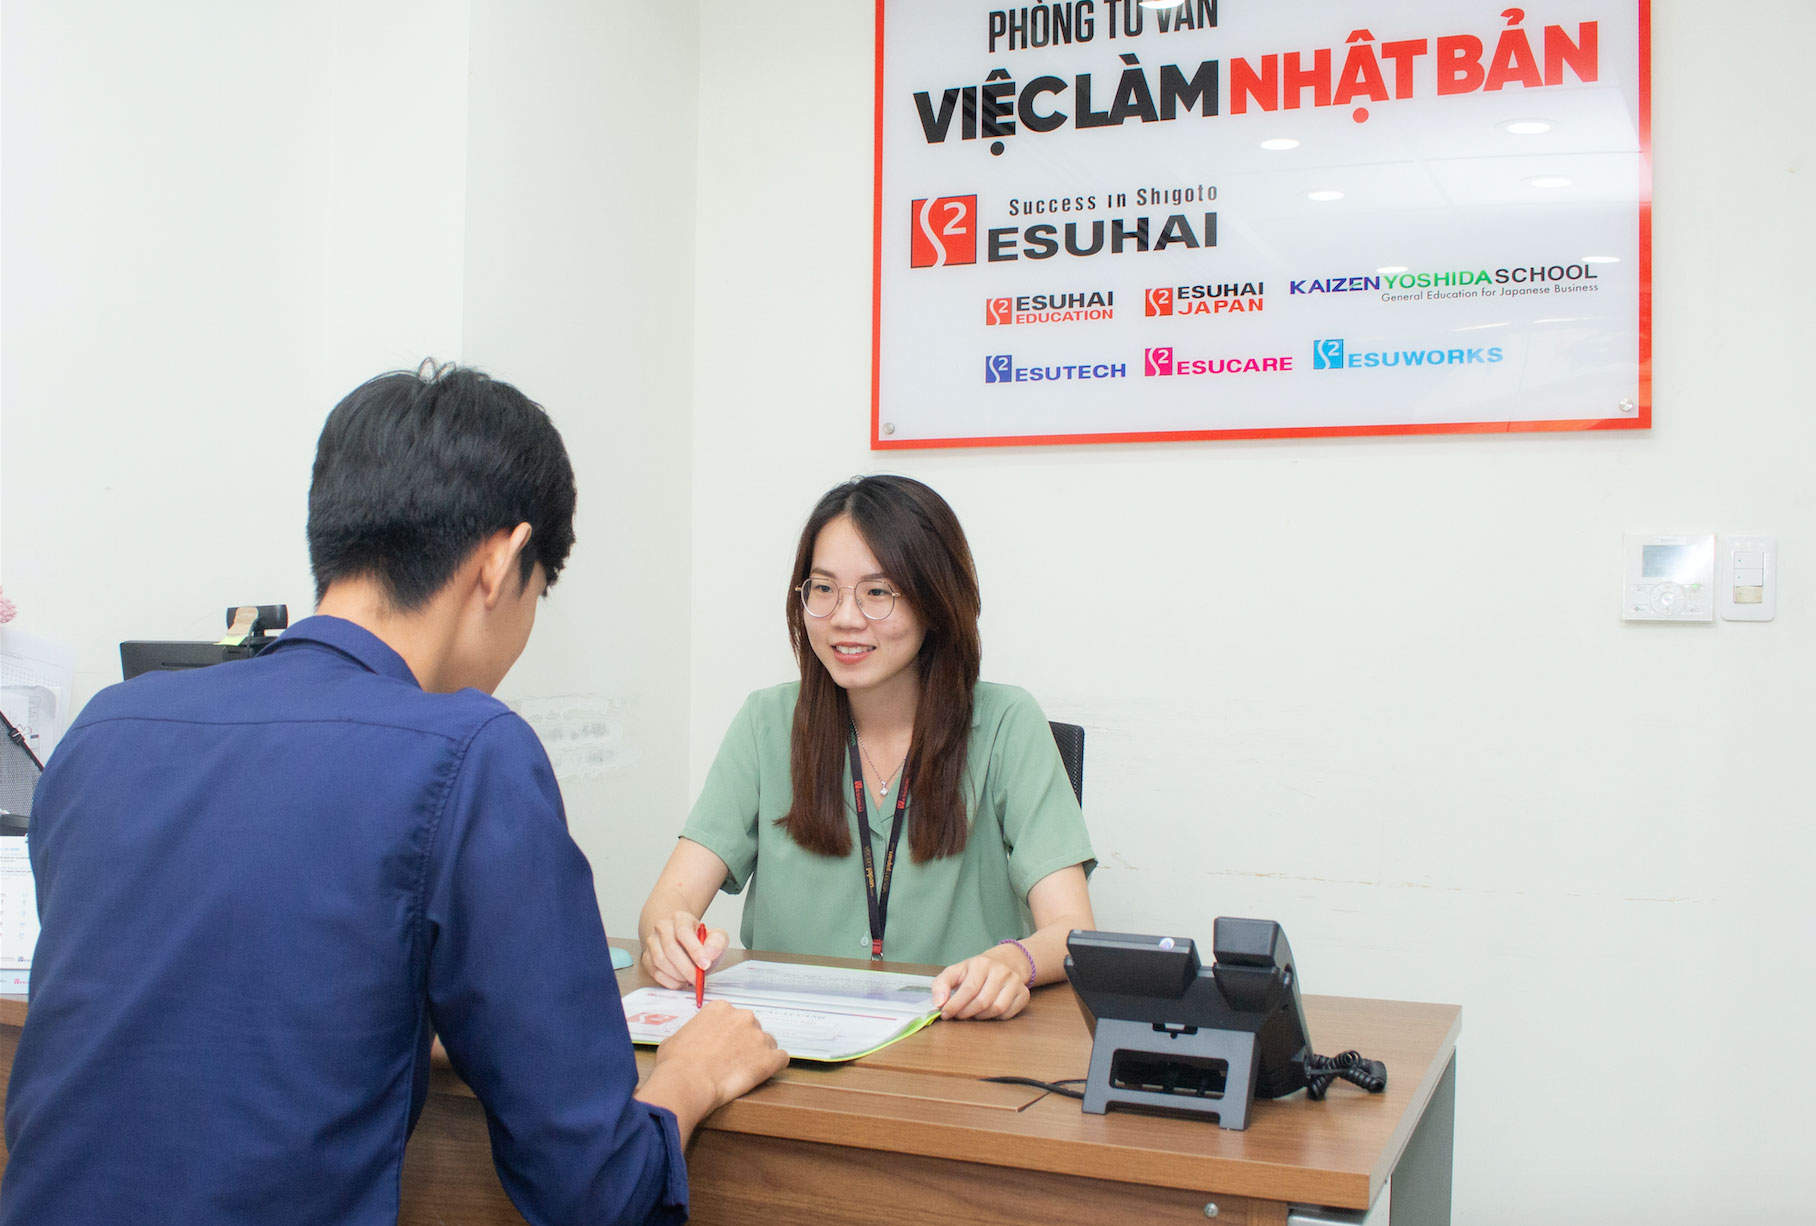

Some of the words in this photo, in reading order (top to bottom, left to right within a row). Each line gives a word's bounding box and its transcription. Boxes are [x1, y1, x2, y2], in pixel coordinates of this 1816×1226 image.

[913, 68, 1068, 156] VIỆC
[1075, 52, 1219, 129] LÀM
[1230, 29, 1427, 123] NHẬT
[1437, 8, 1598, 96] BẢN
[1009, 198, 1096, 216] Success
[1108, 193, 1126, 208] in
[1137, 185, 1218, 206] Shigoto
[988, 212, 1218, 262] ESUHAI
[1177, 282, 1264, 300] ESUHAI
[1381, 290, 1423, 302] General
[1427, 288, 1477, 300] Education
[1481, 286, 1497, 297] for
[1499, 285, 1551, 298] Japanese
[1554, 282, 1599, 294] Business
[1016, 291, 1114, 312] ESUHAI
[1177, 298, 1264, 315] JAPAN
[1016, 309, 1114, 324] EDUCATION
[1177, 357, 1293, 375] ESUCARE
[1348, 347, 1503, 368] ESUWORKS
[1016, 363, 1126, 382] ESUTECH
